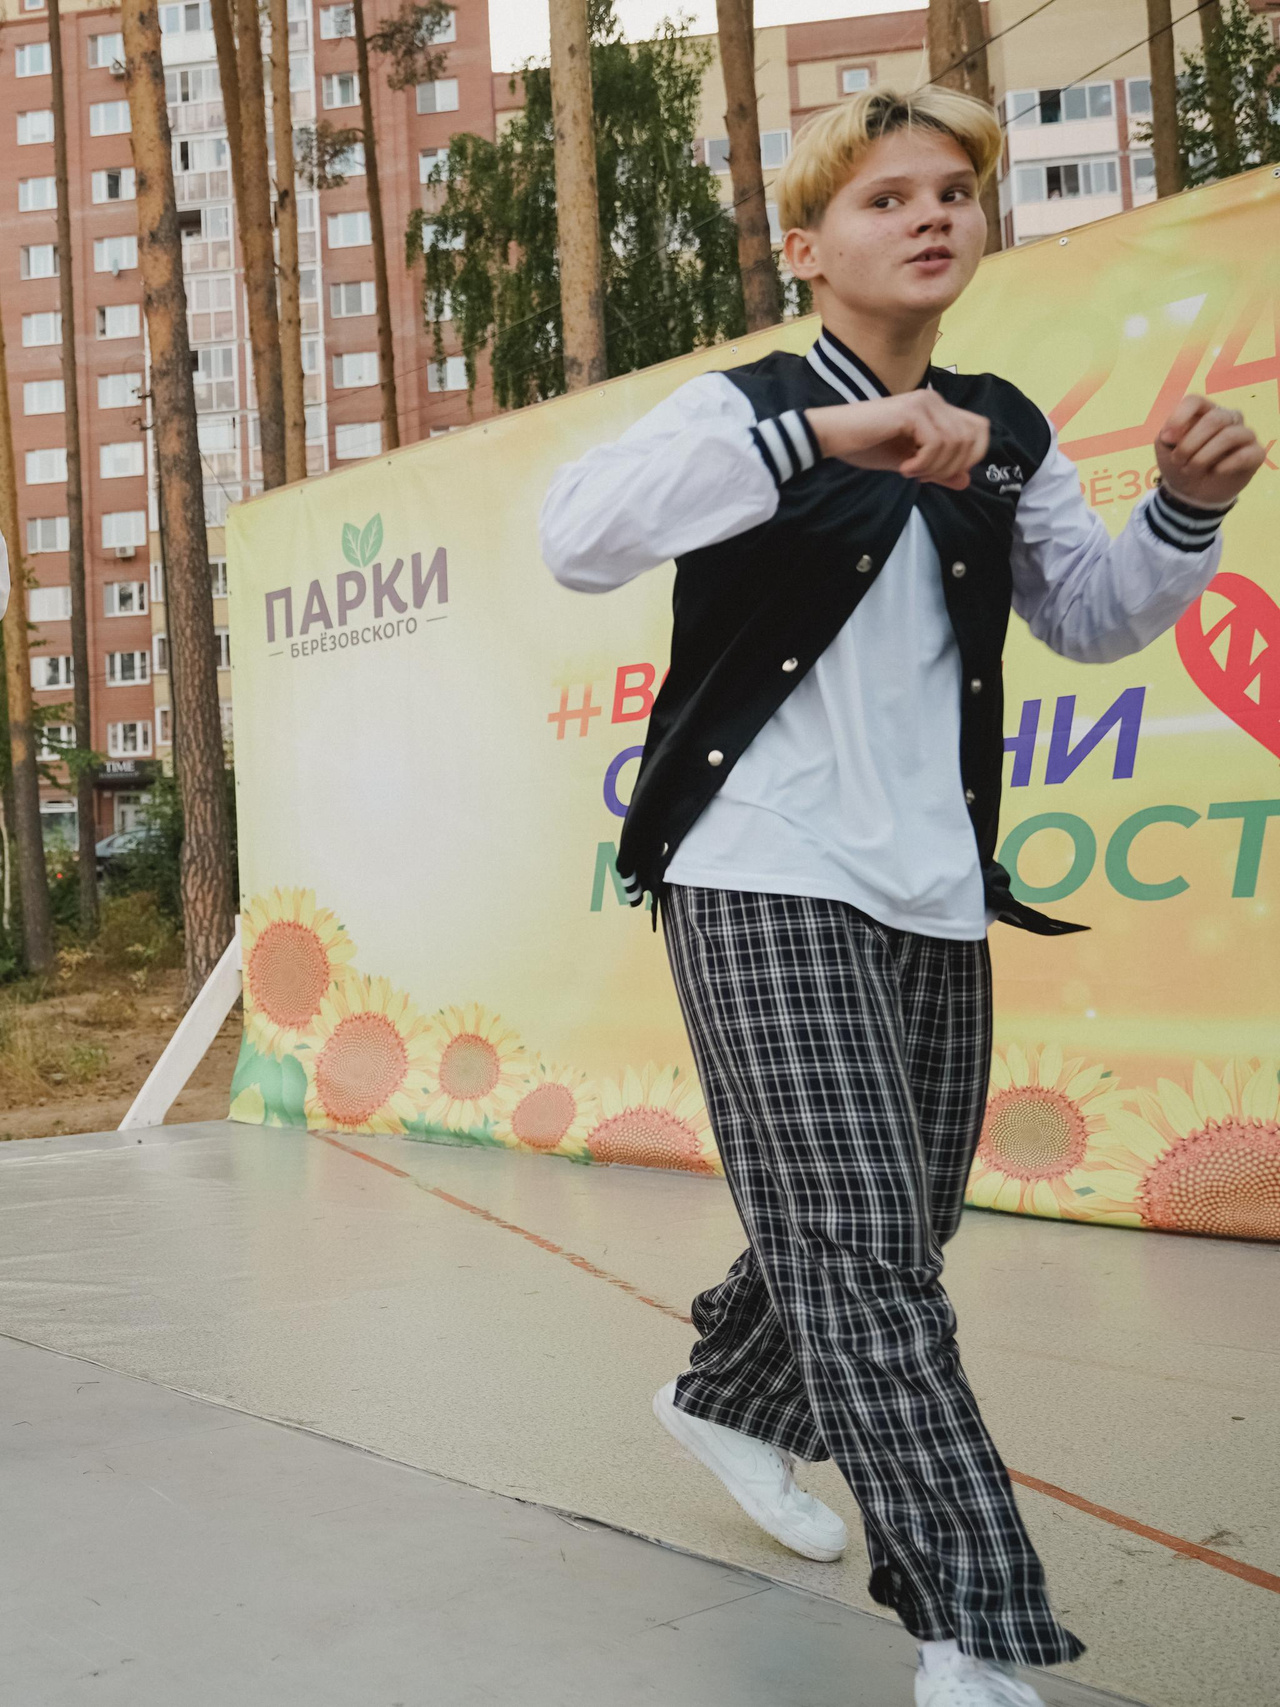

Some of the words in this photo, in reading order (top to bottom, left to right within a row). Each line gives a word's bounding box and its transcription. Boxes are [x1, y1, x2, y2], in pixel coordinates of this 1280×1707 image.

[265, 546, 449, 643] ПАРКИ
[289, 616, 418, 659] БЕРЁЗОВСКОГО
[105, 760, 135, 773] TIME
